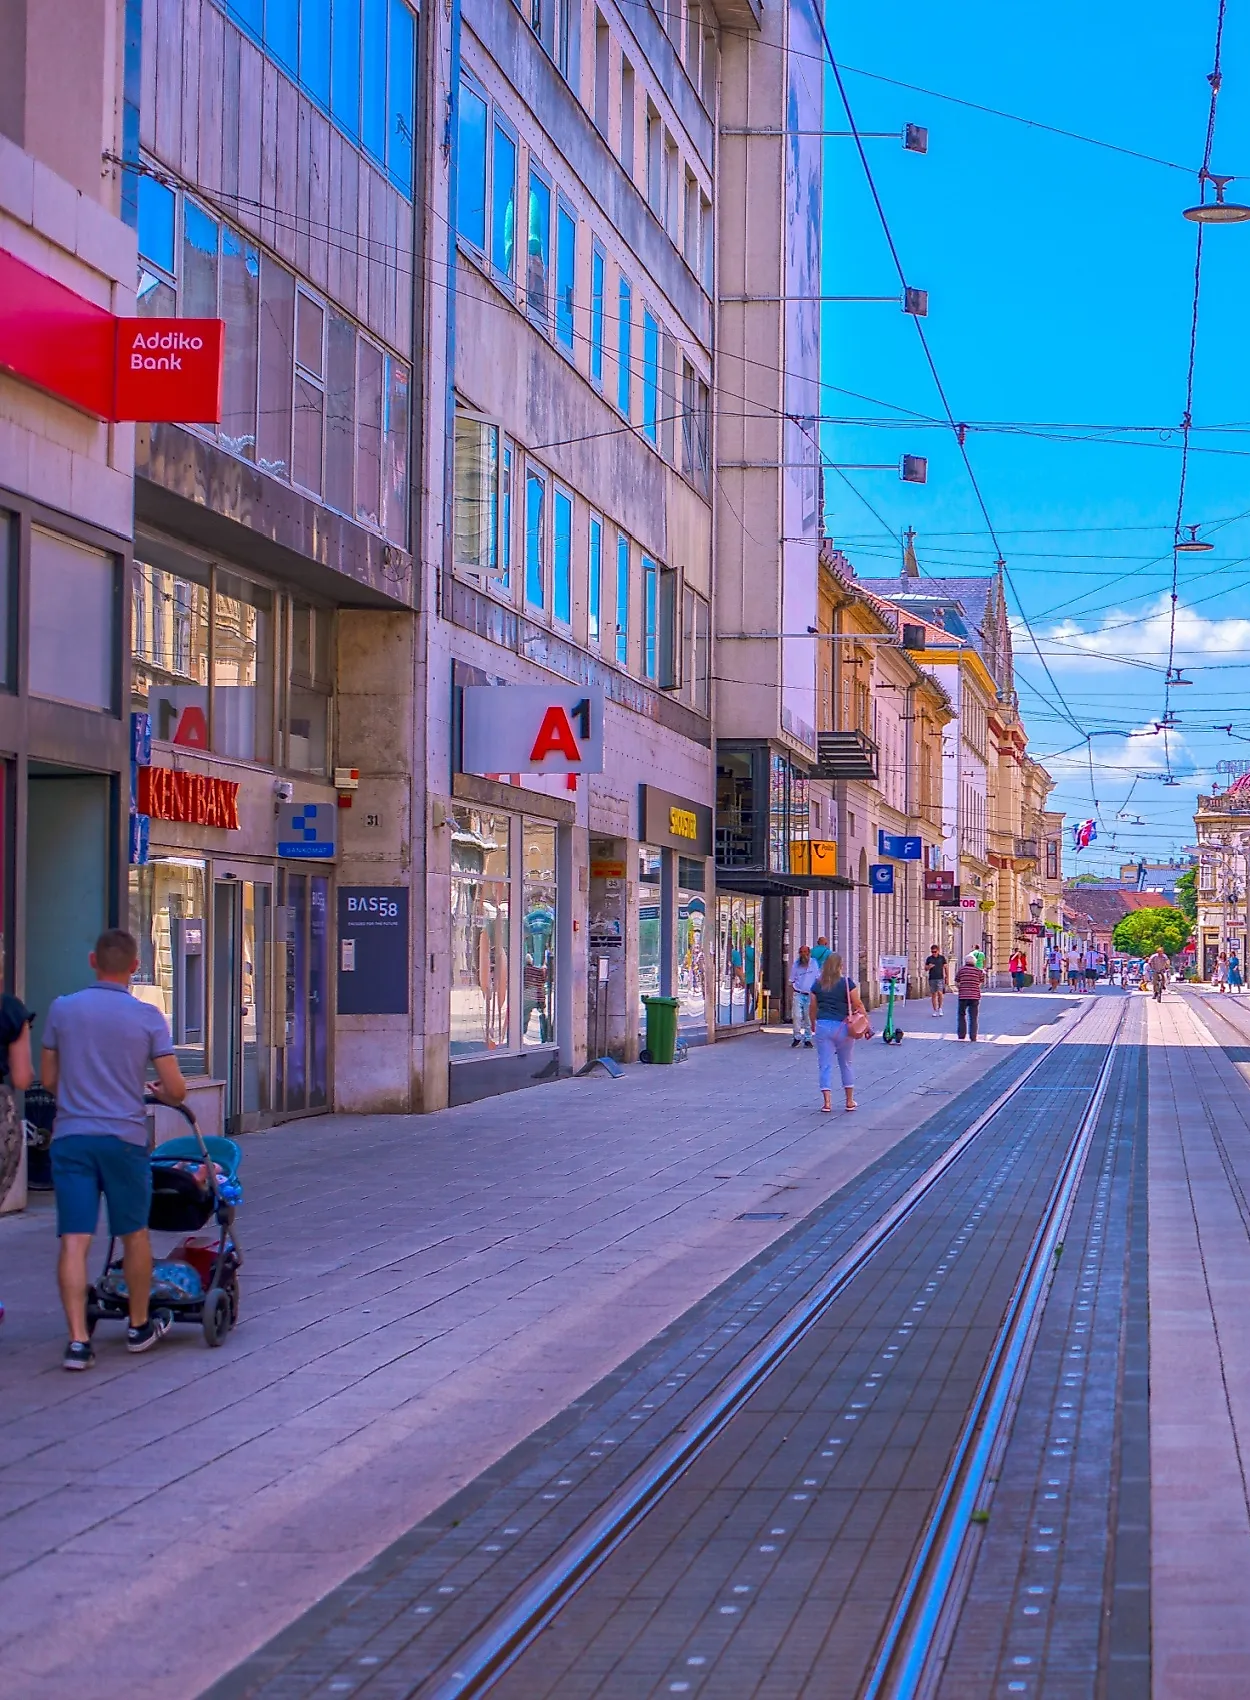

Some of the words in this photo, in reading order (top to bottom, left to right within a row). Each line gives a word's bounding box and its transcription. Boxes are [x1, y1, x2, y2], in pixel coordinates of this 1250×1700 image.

[132, 332, 203, 350] Addiko
[131, 353, 182, 370] Bank
[530, 699, 591, 761] A1
[149, 766, 241, 831] KENTBANK
[367, 815, 379, 826] 31
